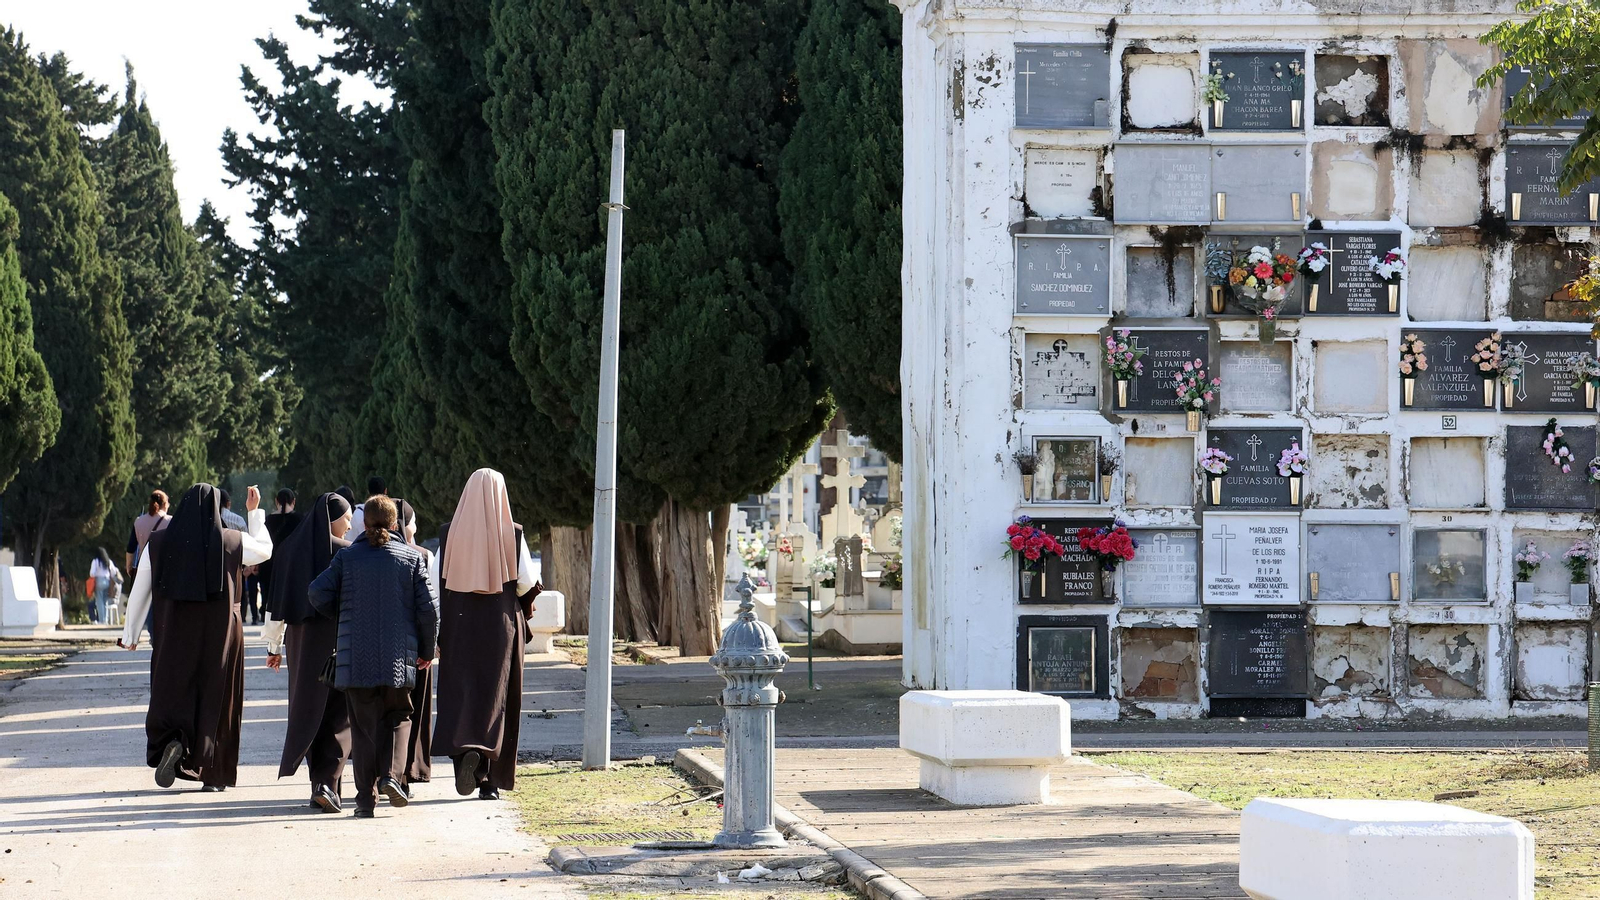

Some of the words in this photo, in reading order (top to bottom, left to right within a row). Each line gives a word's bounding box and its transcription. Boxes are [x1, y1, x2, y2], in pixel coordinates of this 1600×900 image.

[1516, 166, 1522, 174] R
[1536, 166, 1539, 174] I
[1031, 284, 1058, 292] SANCHEZ
[1059, 284, 1093, 293] DOMINGUEZ
[1429, 374, 1470, 382] ALVAREZ
[1444, 418, 1454, 427] 32
[1237, 453, 1240, 461] I
[1226, 477, 1261, 485] CUEVAS
[1262, 477, 1284, 485] SOTO
[1255, 536, 1282, 544] PEÑALVER
[1252, 548, 1260, 556] DE
[1261, 548, 1272, 556] LOS
[1063, 572, 1095, 580] RUBIALES
[1064, 582, 1092, 590] FRANCO
